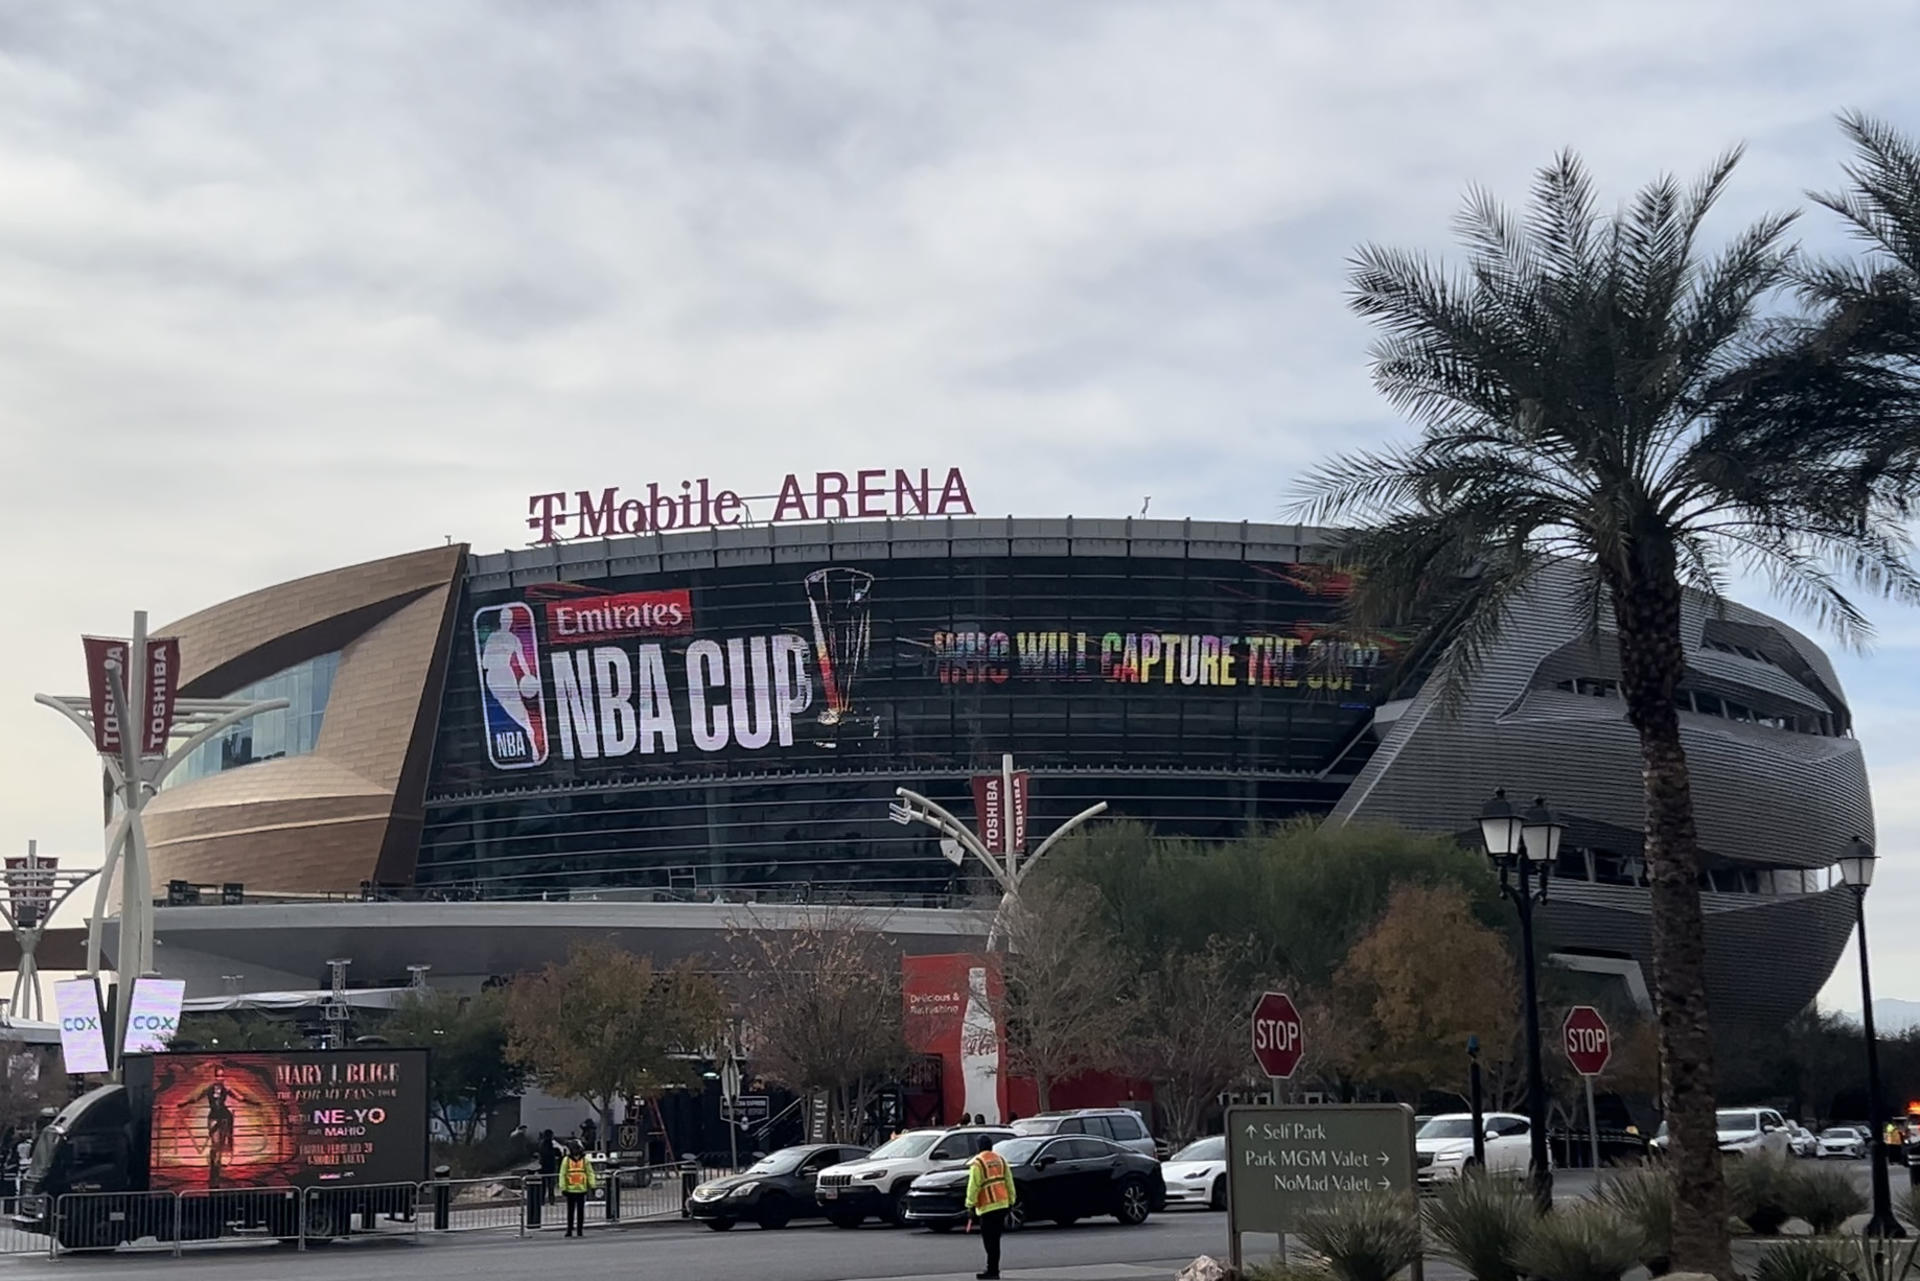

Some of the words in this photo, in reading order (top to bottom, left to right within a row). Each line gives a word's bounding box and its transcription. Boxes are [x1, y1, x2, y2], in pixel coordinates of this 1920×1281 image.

[773, 467, 976, 521] ARENA
[557, 600, 683, 635] Emirates
[1100, 632, 1236, 686] CAPTURE
[1246, 635, 1301, 687] THE
[150, 645, 166, 749] TOSHIBA
[551, 644, 678, 760] NBA
[686, 634, 813, 751] CUP
[496, 732, 527, 757] NBA
[986, 780, 998, 849] TOSHIBA
[63, 1016, 98, 1031] COX
[133, 1016, 175, 1030] COX
[1256, 1018, 1299, 1052] STOP
[1568, 1028, 1606, 1053] STOP
[276, 1064, 324, 1085] MARY
[313, 1107, 386, 1124] NE-YO
[324, 1126, 367, 1137] MARIO
[1263, 1123, 1291, 1140] Self
[1294, 1123, 1327, 1140] Park
[1245, 1150, 1277, 1166] Park
[1281, 1150, 1327, 1167] MGM
[1331, 1151, 1369, 1167] Valet
[1274, 1174, 1329, 1192] NoMad
[1332, 1175, 1372, 1192] Valet
